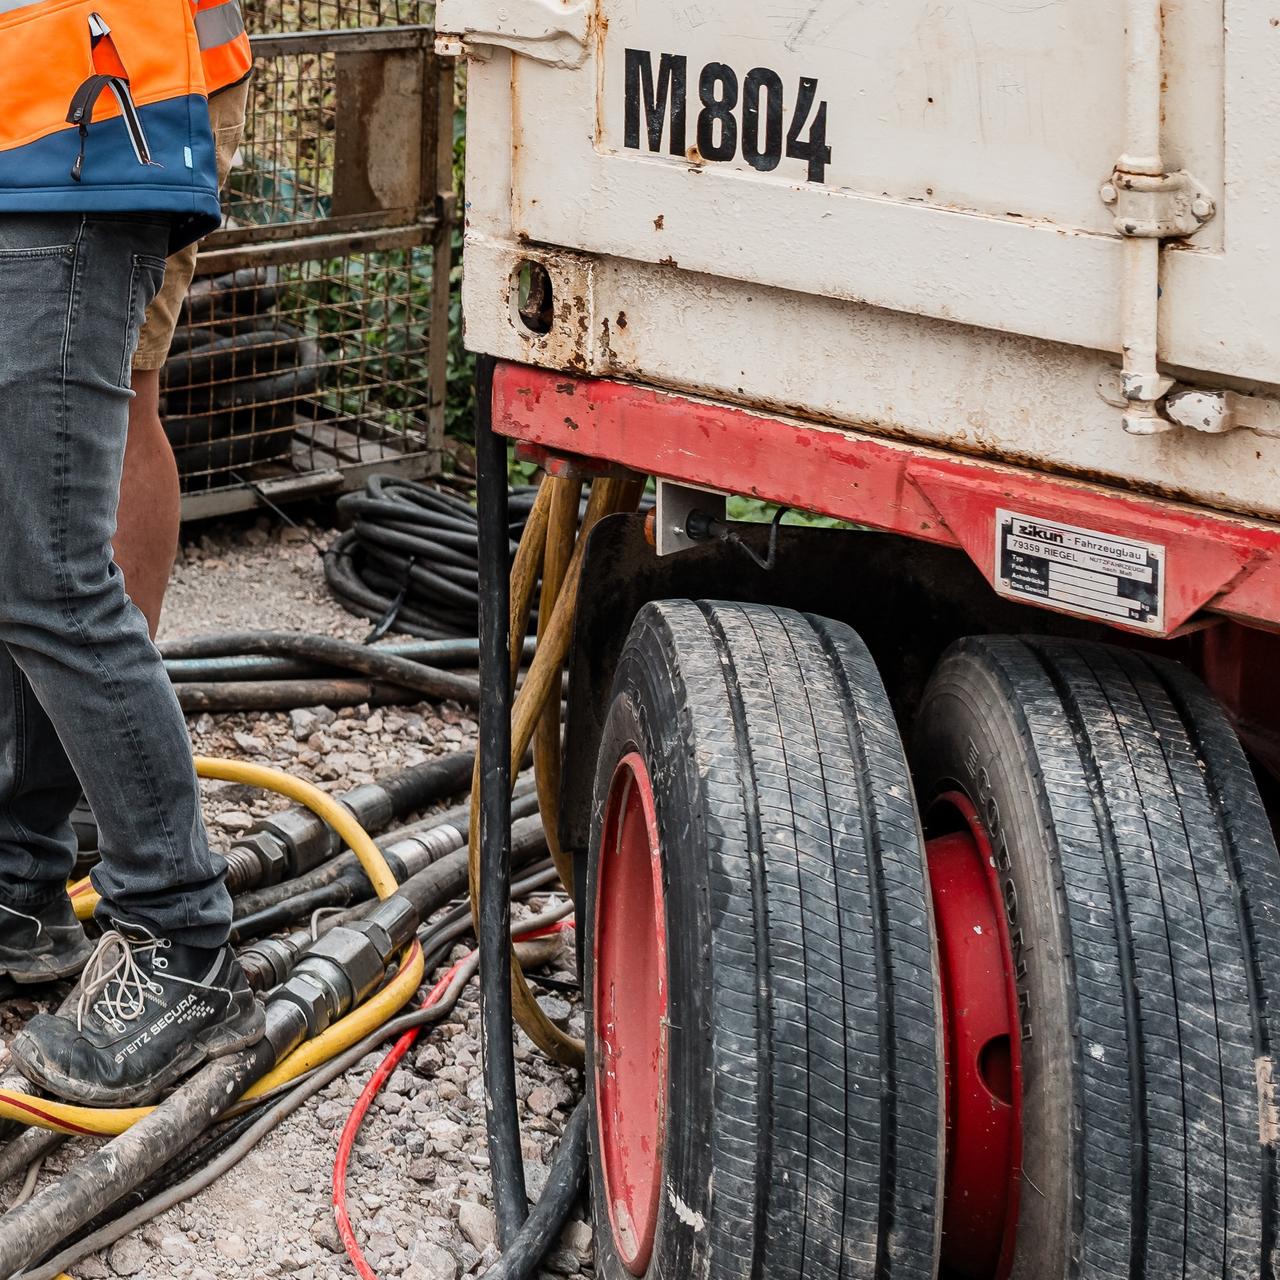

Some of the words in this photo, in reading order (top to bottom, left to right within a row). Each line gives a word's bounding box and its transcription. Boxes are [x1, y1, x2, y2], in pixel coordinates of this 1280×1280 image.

[624, 48, 831, 183] M804
[1012, 539, 1040, 553] 79359
[1043, 547, 1078, 563] RIEGEL
[1018, 524, 1064, 544] zikun
[1074, 537, 1142, 561] Fahrzeugbau
[1089, 556, 1145, 573] NUTZFAHRZEUGE
[114, 1031, 152, 1064] STEITZ
[149, 993, 198, 1036] SECURA
